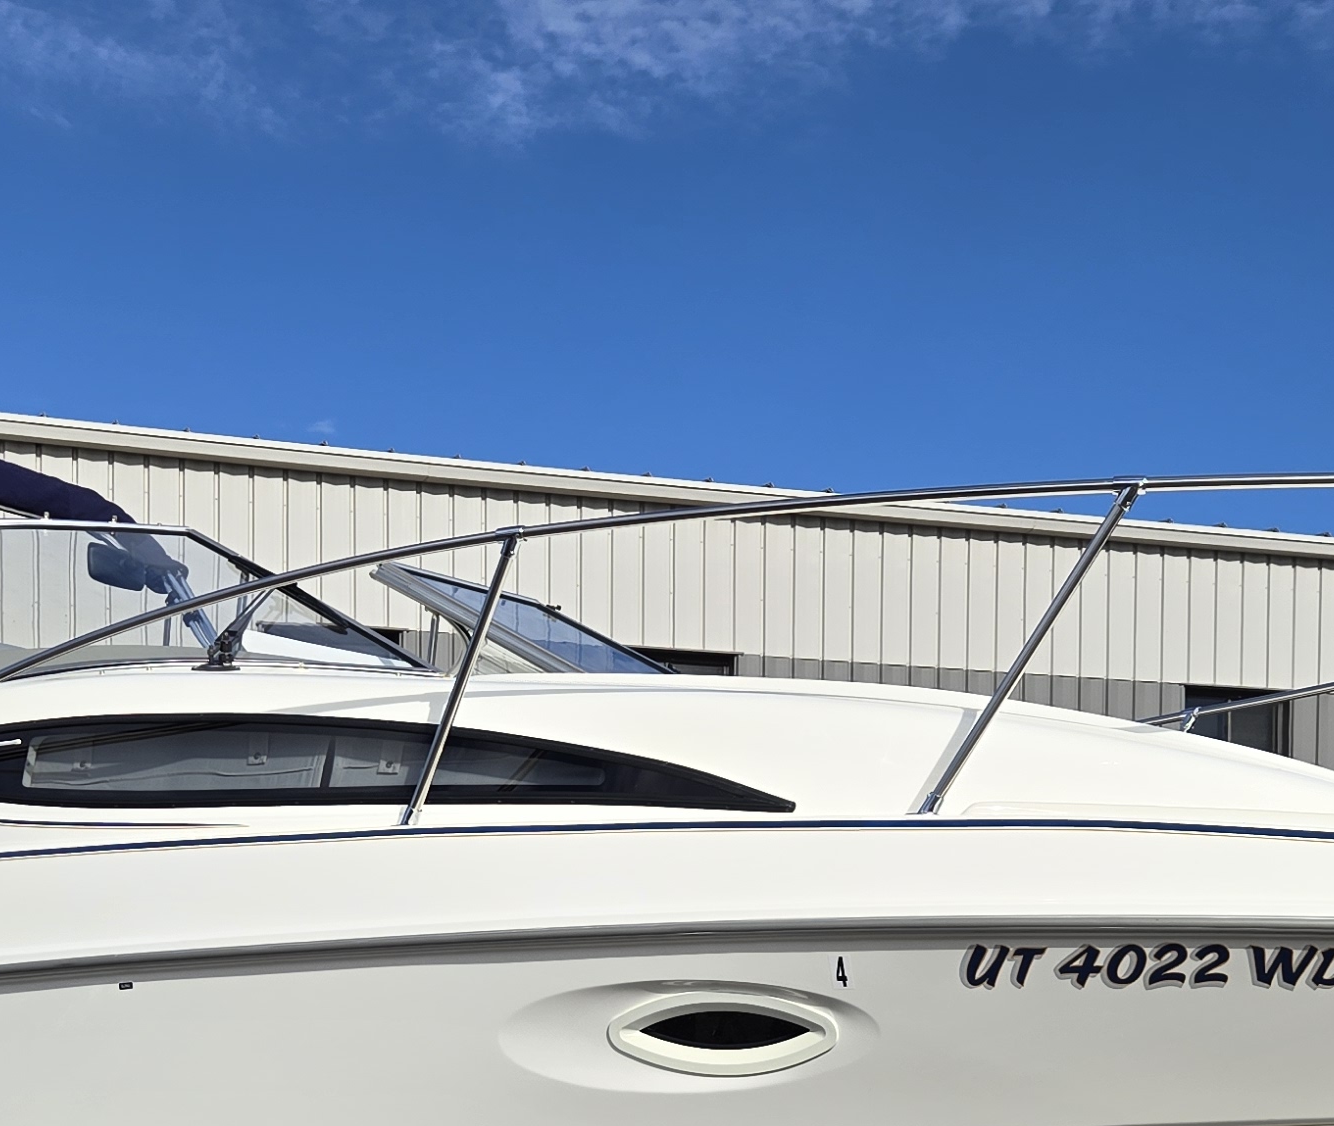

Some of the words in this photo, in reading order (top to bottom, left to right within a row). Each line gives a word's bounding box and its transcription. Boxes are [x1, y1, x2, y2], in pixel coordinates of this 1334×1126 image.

[835, 955, 849, 988] 4
[959, 944, 1048, 990] UT
[1053, 942, 1231, 990] 4022
